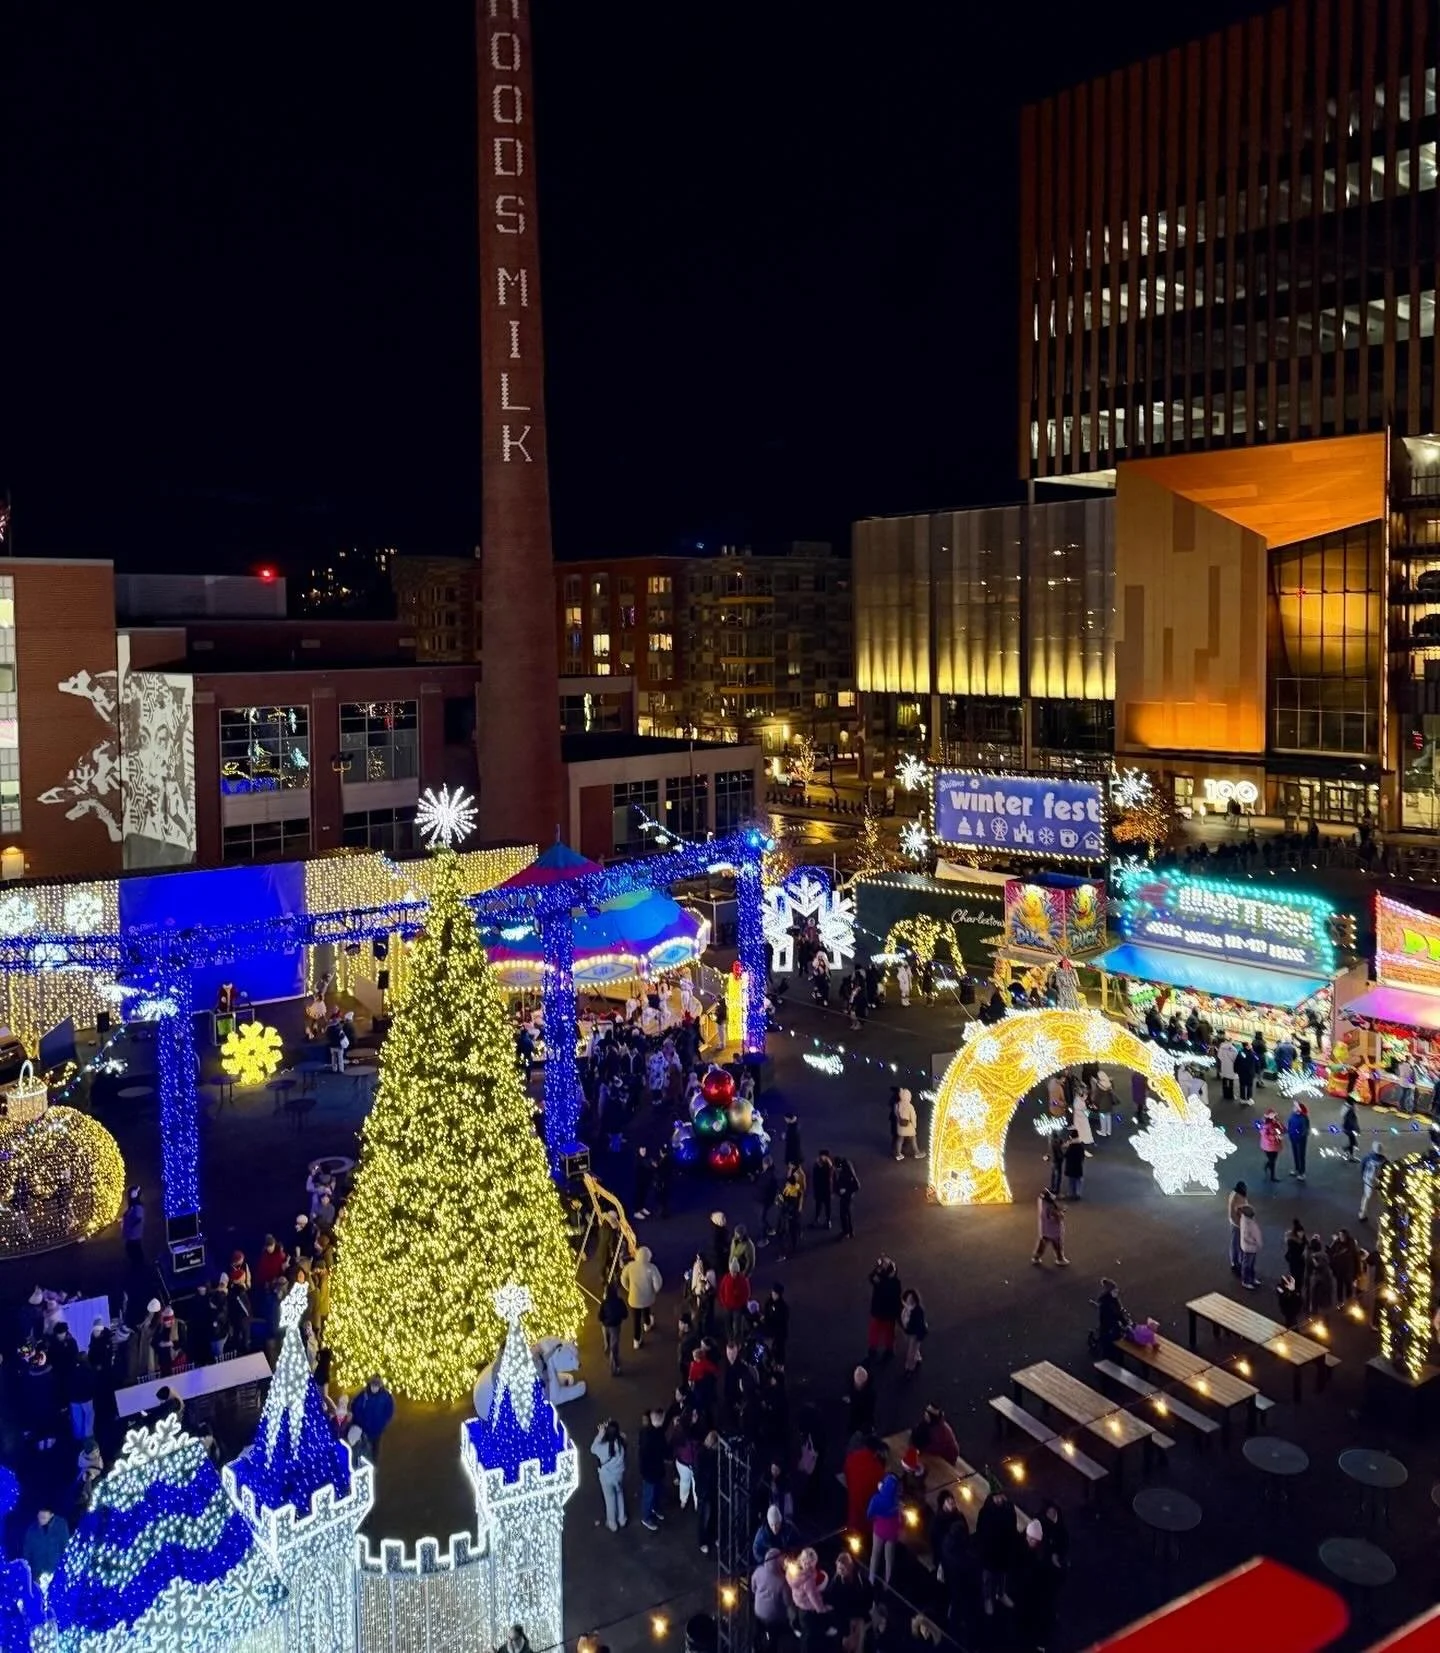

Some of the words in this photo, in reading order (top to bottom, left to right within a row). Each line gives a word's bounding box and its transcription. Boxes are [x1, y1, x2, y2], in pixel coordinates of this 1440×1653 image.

[497, 267, 532, 462] MILK
[950, 790, 1033, 817] winter
[1043, 792, 1100, 823] fest
[1203, 779, 1258, 803] 100
